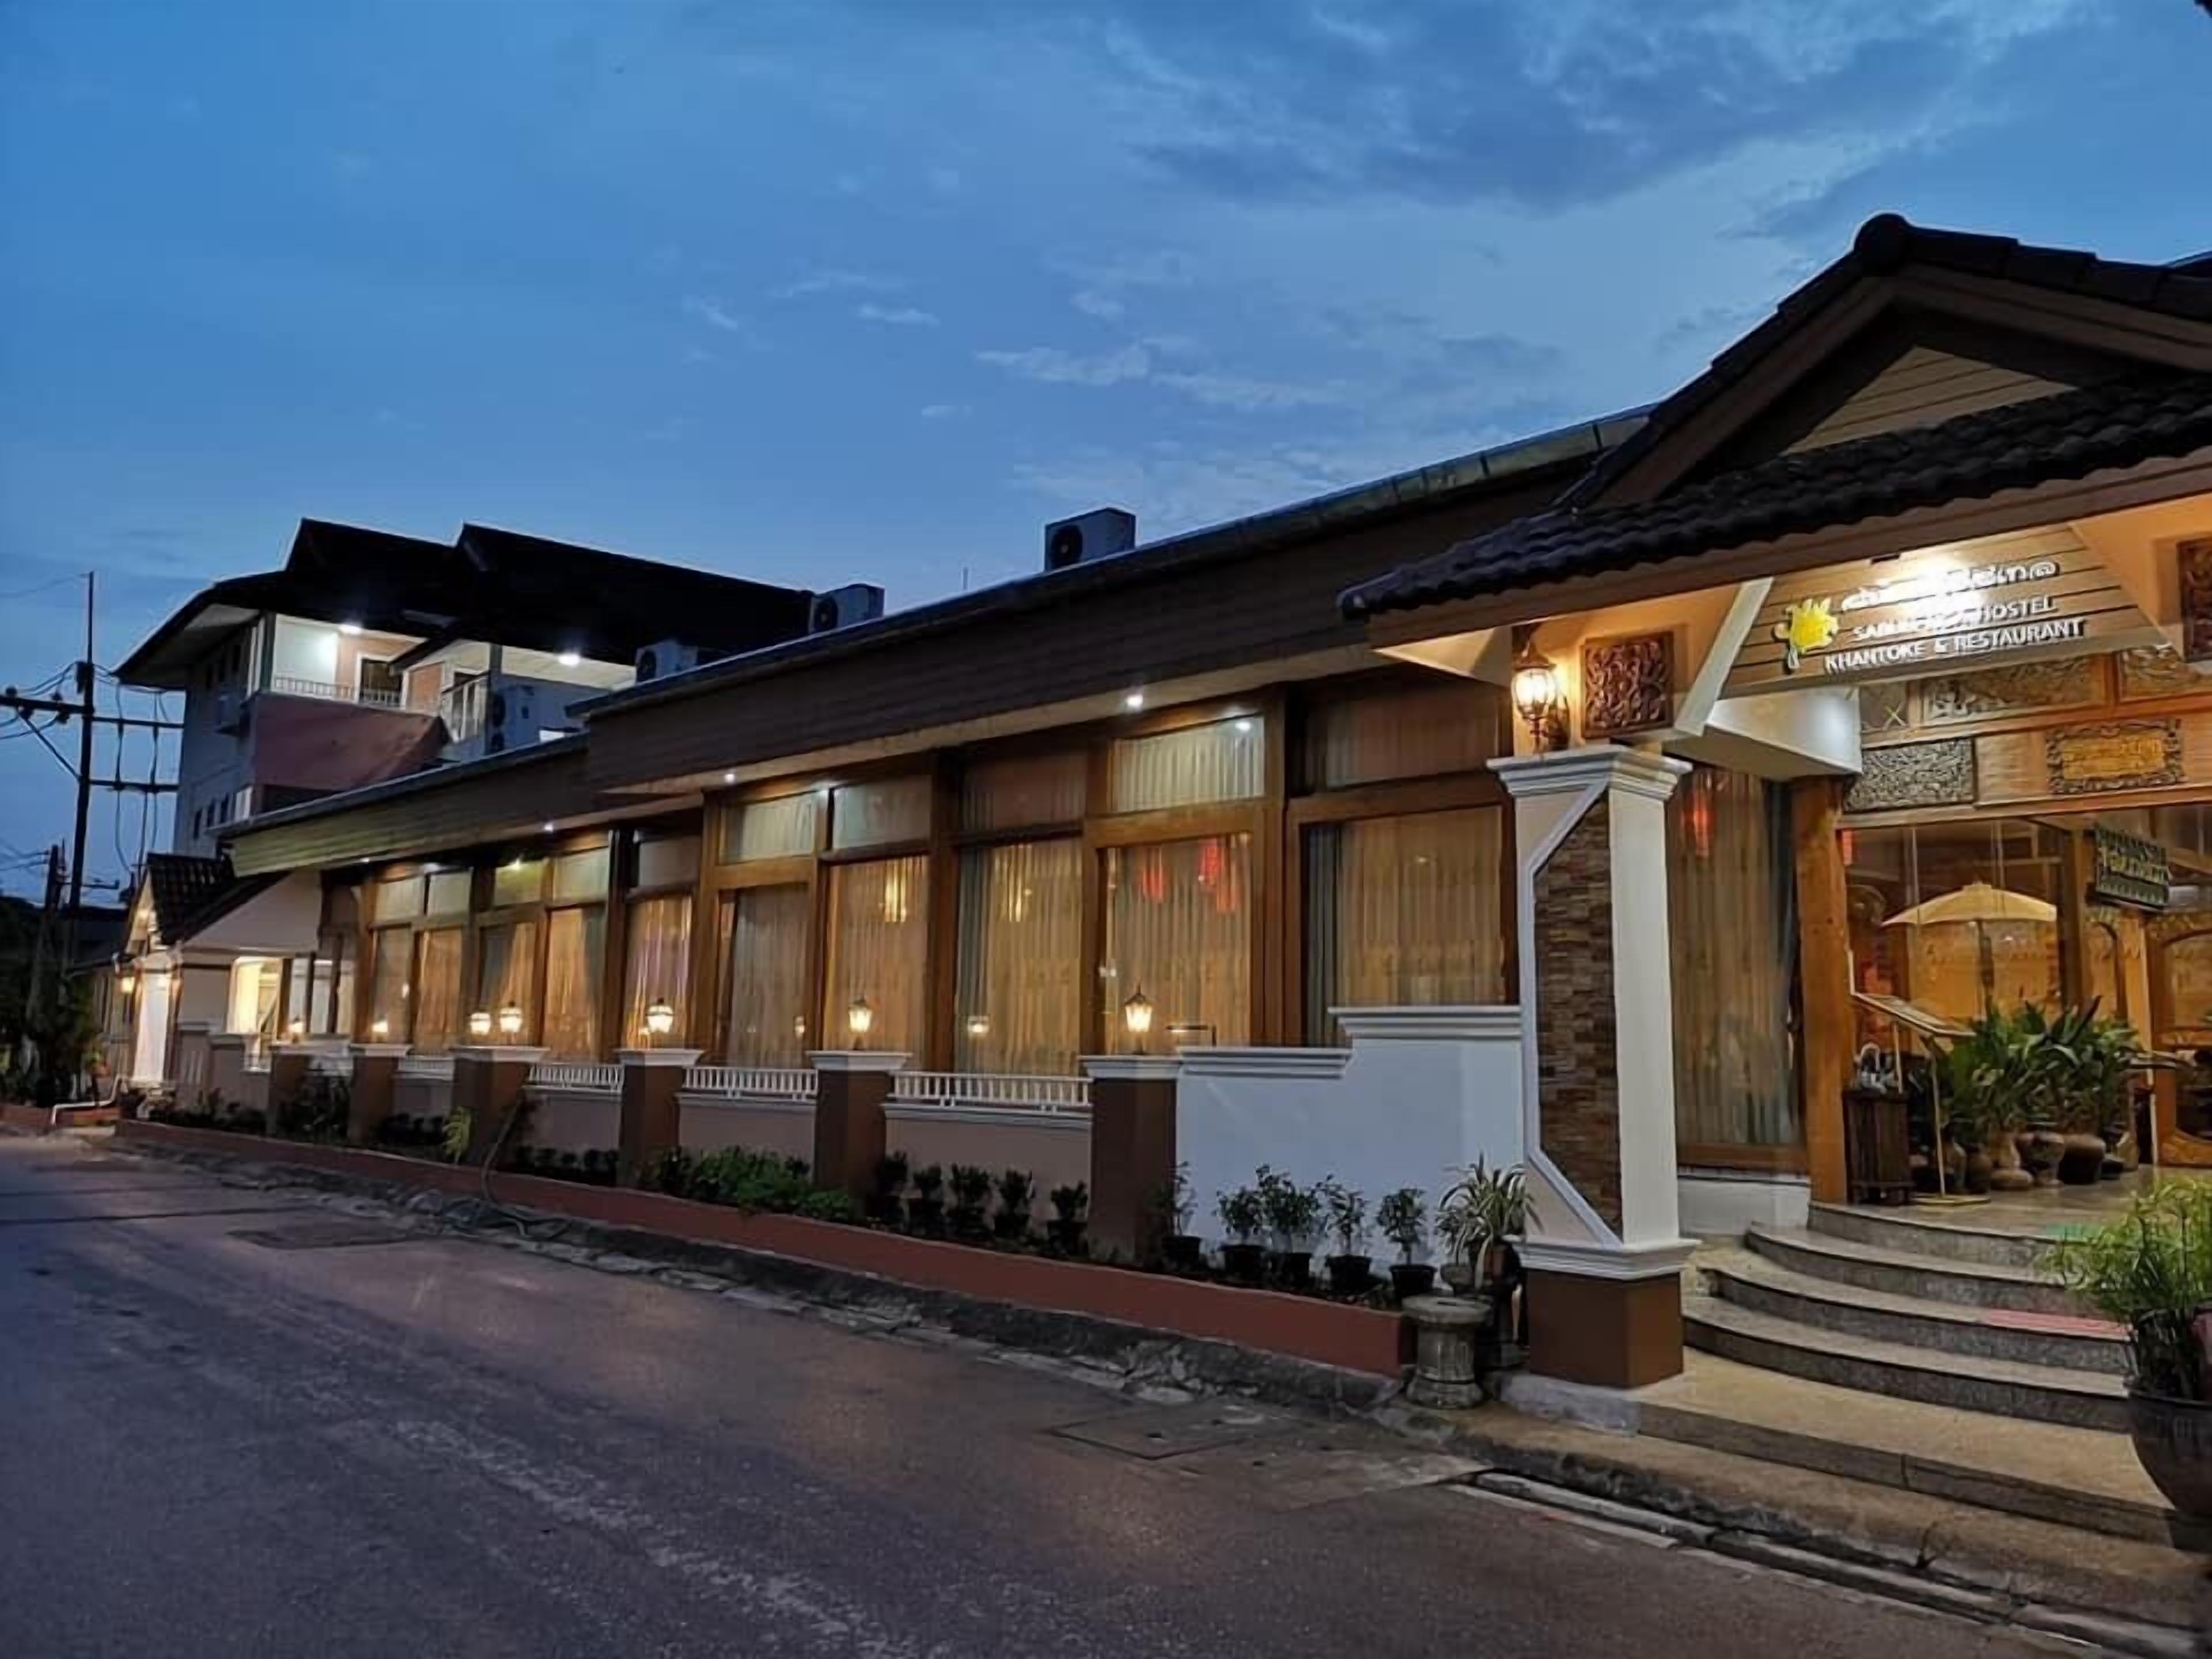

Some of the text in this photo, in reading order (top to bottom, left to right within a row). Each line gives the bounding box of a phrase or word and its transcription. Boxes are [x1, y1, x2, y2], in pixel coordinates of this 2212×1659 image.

[1980, 593, 2058, 623] HOSTEL
[1824, 641, 1926, 671] KHANTOKE
[1954, 617, 2085, 653] RESTAURANT
